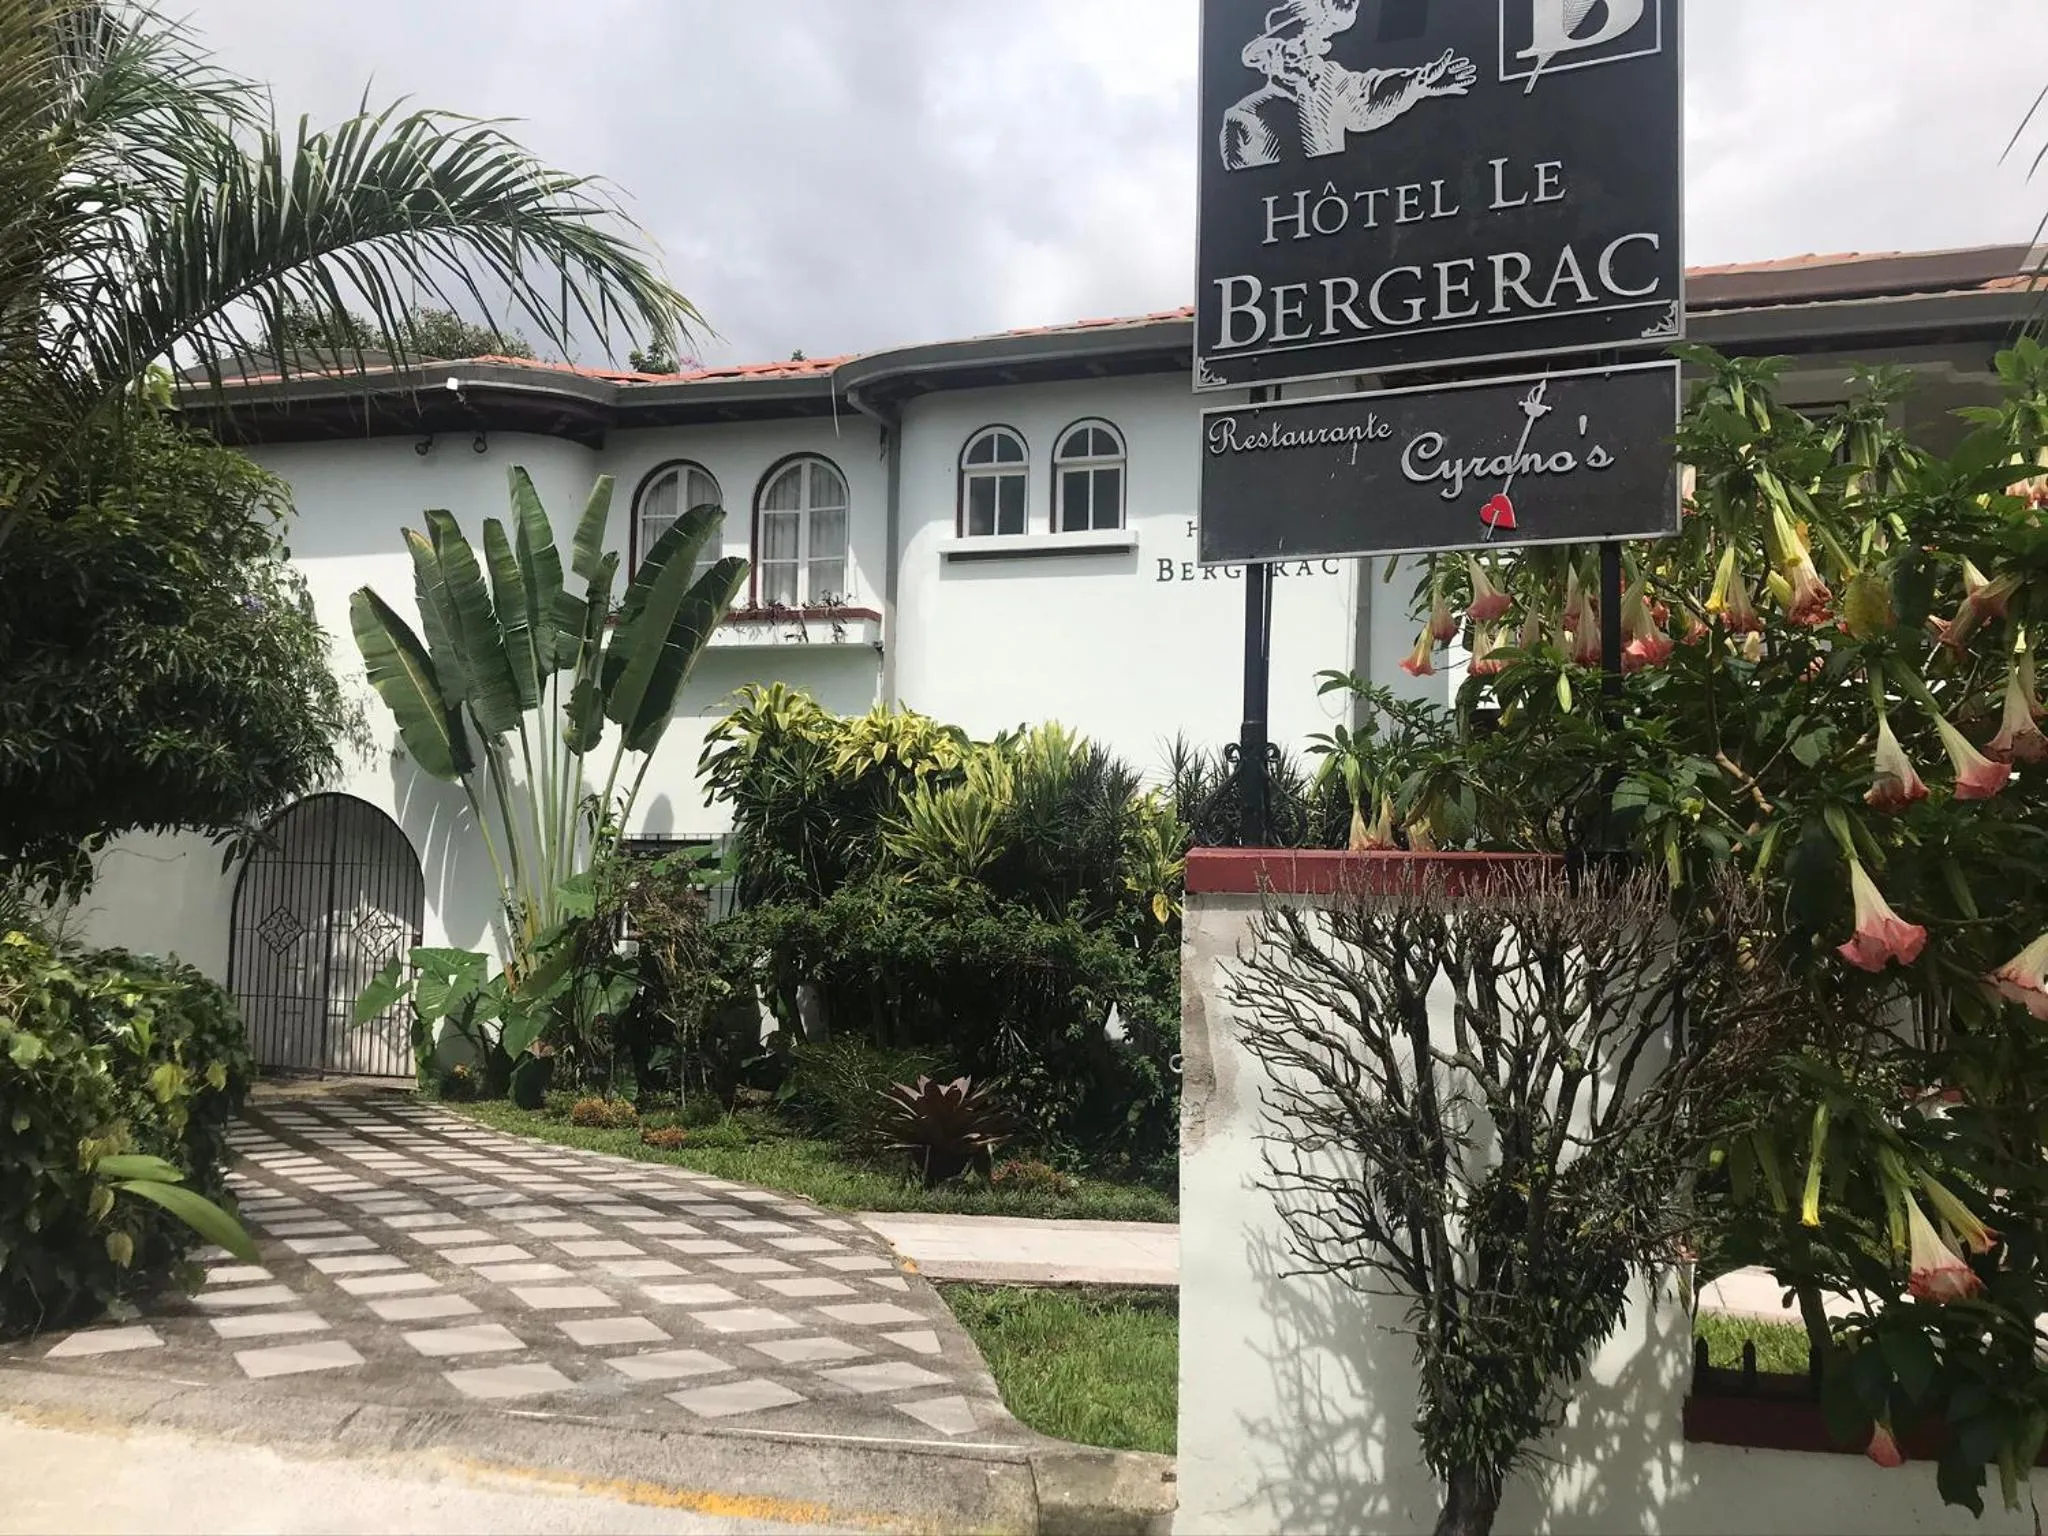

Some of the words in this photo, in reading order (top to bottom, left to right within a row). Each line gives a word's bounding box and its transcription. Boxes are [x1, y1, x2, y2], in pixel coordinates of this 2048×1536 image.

[1262, 179, 1460, 244] HÔTEL
[1488, 157, 1567, 210] LE
[1212, 232, 1660, 351] BERGERAC
[1208, 411, 1393, 455] Restaurante
[1401, 414, 1616, 499] Cyrano's
[1156, 558, 1340, 582] BERGRAC
